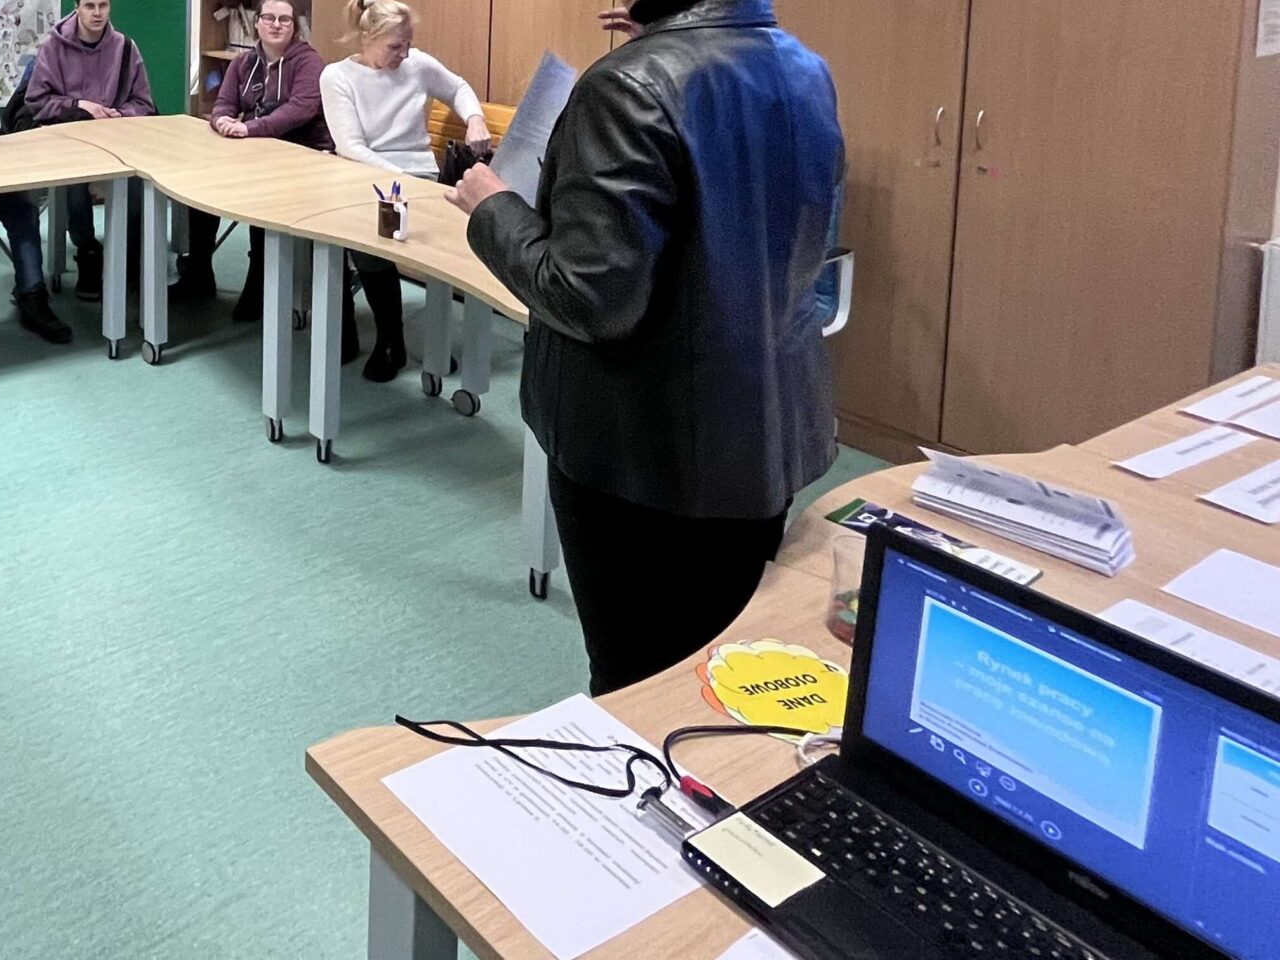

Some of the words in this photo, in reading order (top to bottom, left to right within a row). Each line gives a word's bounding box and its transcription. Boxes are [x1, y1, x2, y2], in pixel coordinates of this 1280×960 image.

[738, 673, 818, 696] OSOBOWE
[976, 649, 1033, 687] Rynek
[1037, 683, 1094, 718] pracy
[776, 693, 828, 711] DANE
